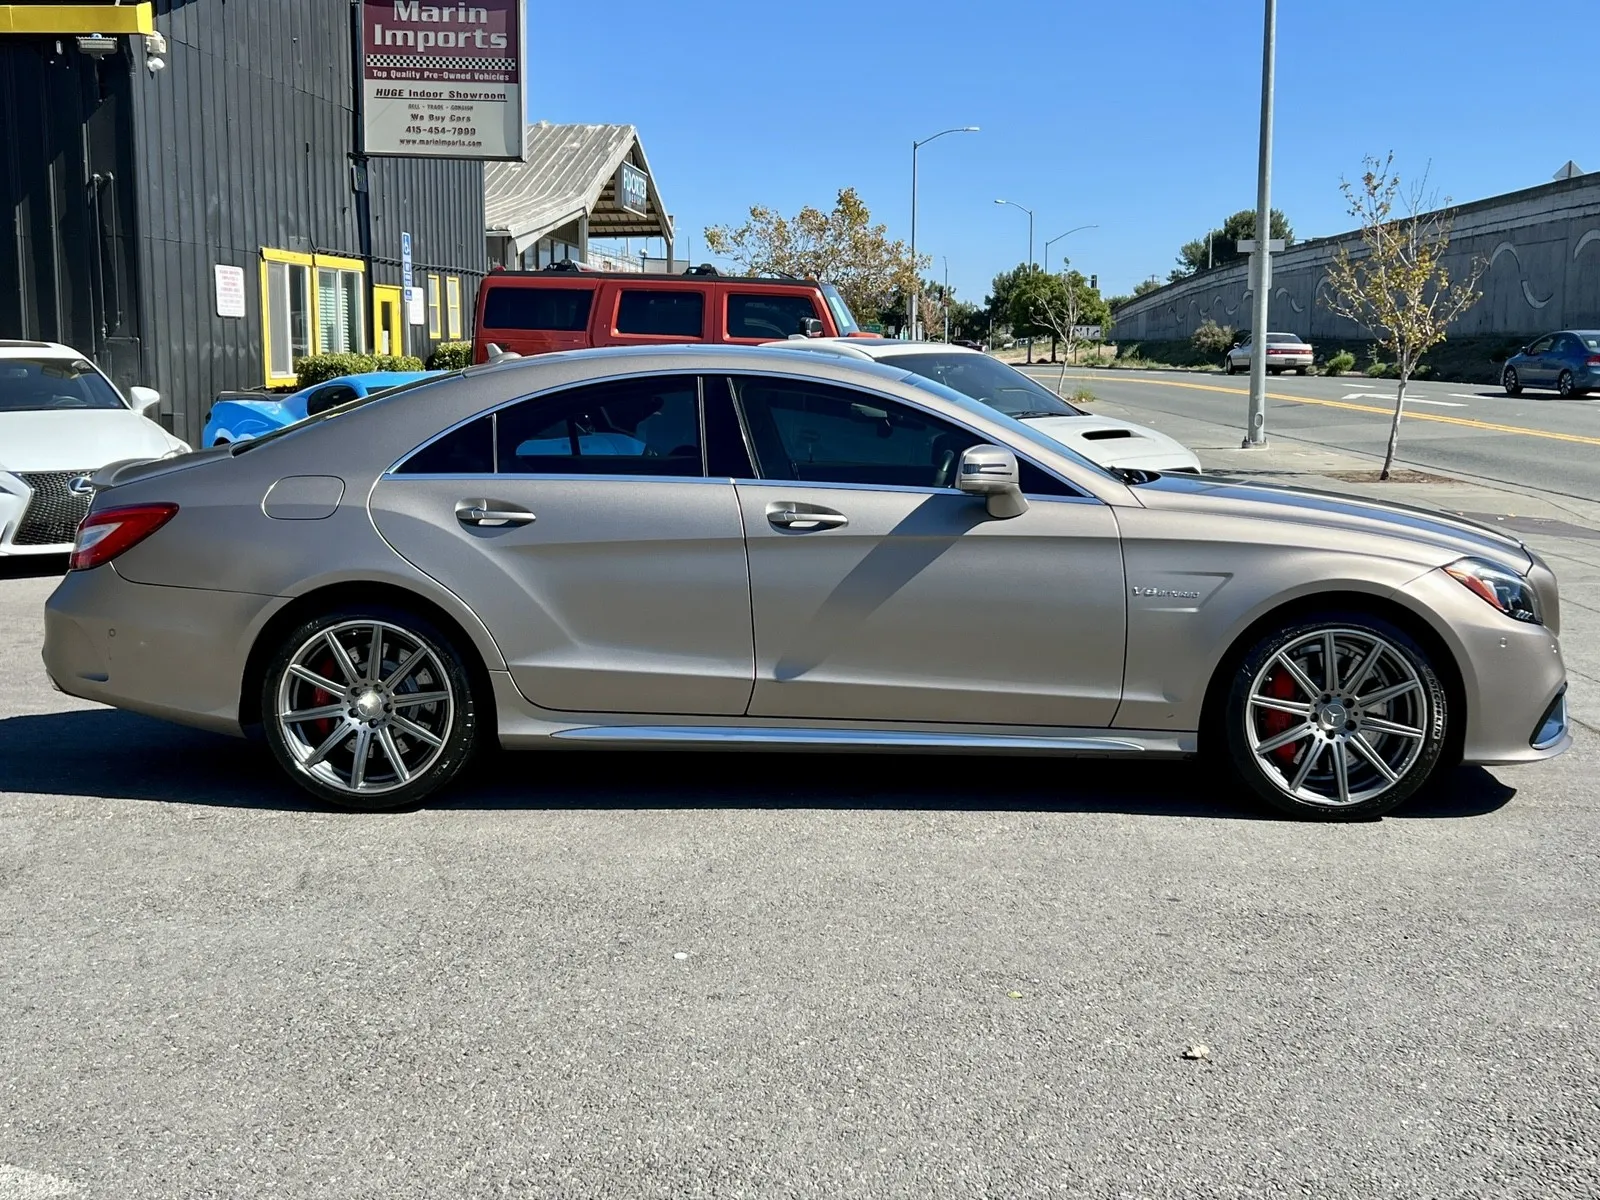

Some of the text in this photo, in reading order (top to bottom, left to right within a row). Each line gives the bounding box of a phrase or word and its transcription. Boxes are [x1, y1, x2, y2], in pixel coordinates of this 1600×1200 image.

[393, 1, 488, 23] Marin
[374, 24, 508, 52] Imports
[372, 69, 510, 81] Top Quality Pre-Owned Vehicles
[375, 88, 507, 100] HUGE Indoor Showroom
[410, 113, 425, 121] We
[428, 114, 446, 122] Buy
